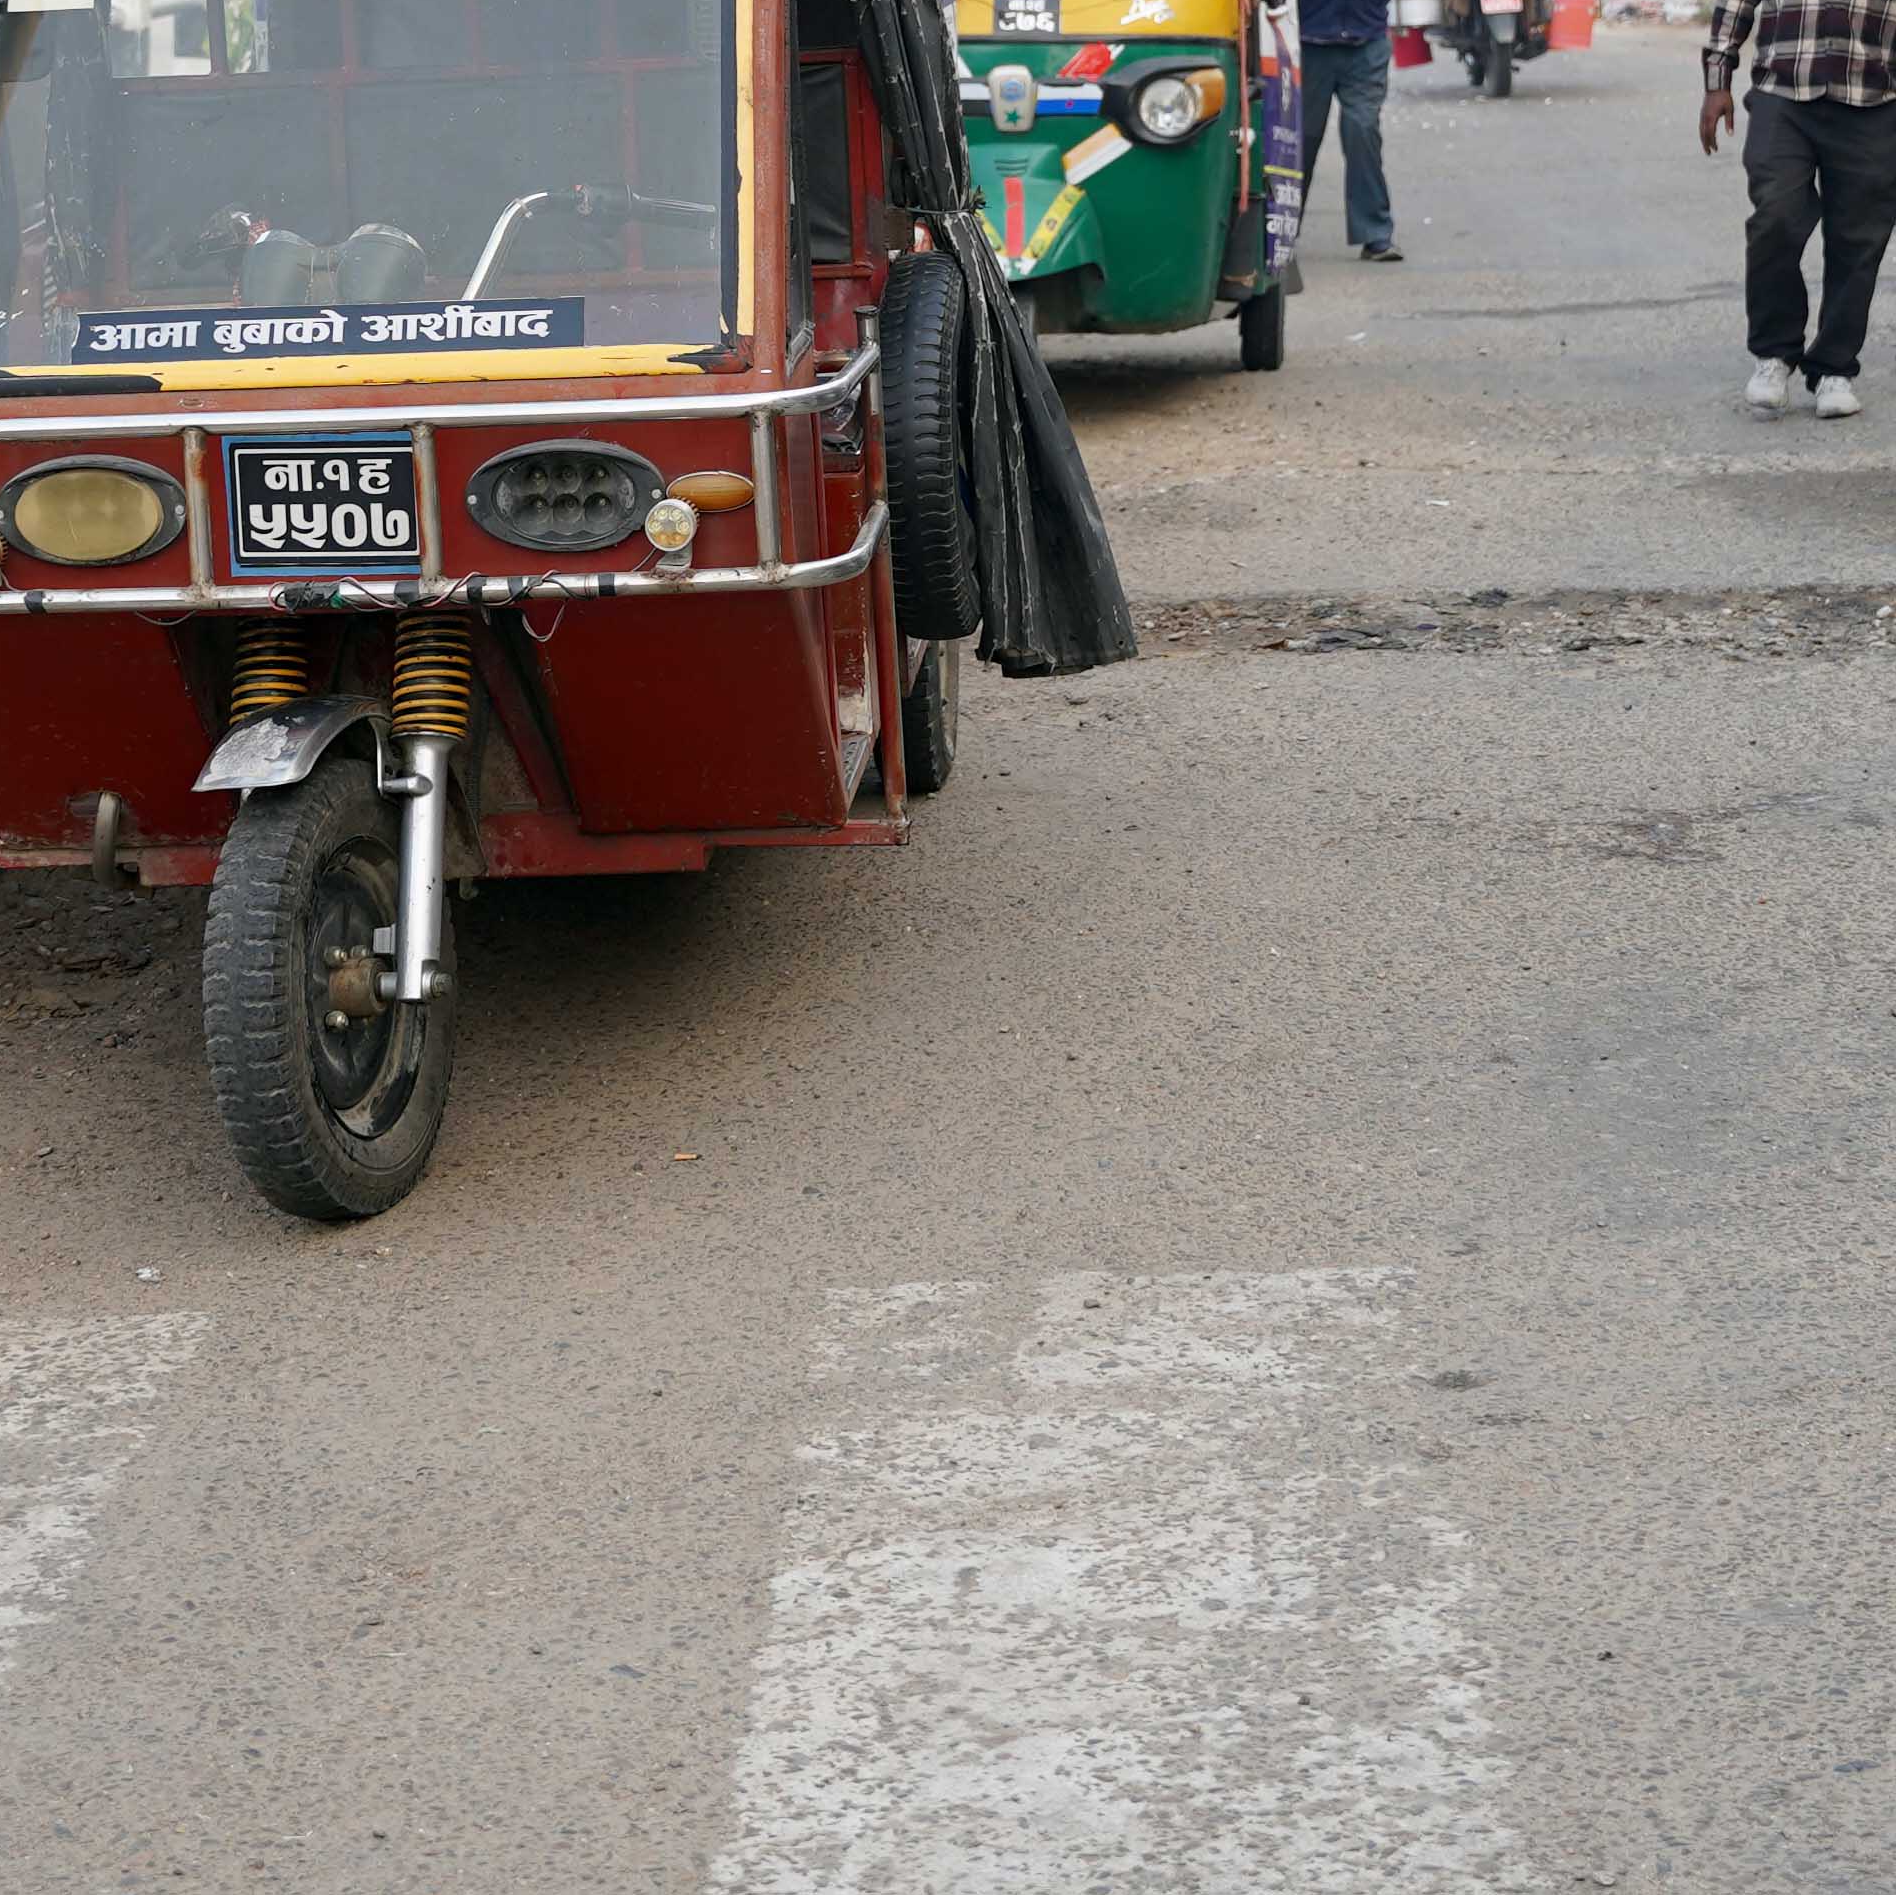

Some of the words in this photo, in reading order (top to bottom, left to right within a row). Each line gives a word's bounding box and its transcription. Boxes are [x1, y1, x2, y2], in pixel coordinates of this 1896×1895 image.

[88, 320, 202, 353] आमा
[212, 308, 348, 354] बुबाको
[248, 502, 411, 550] ५५०७
